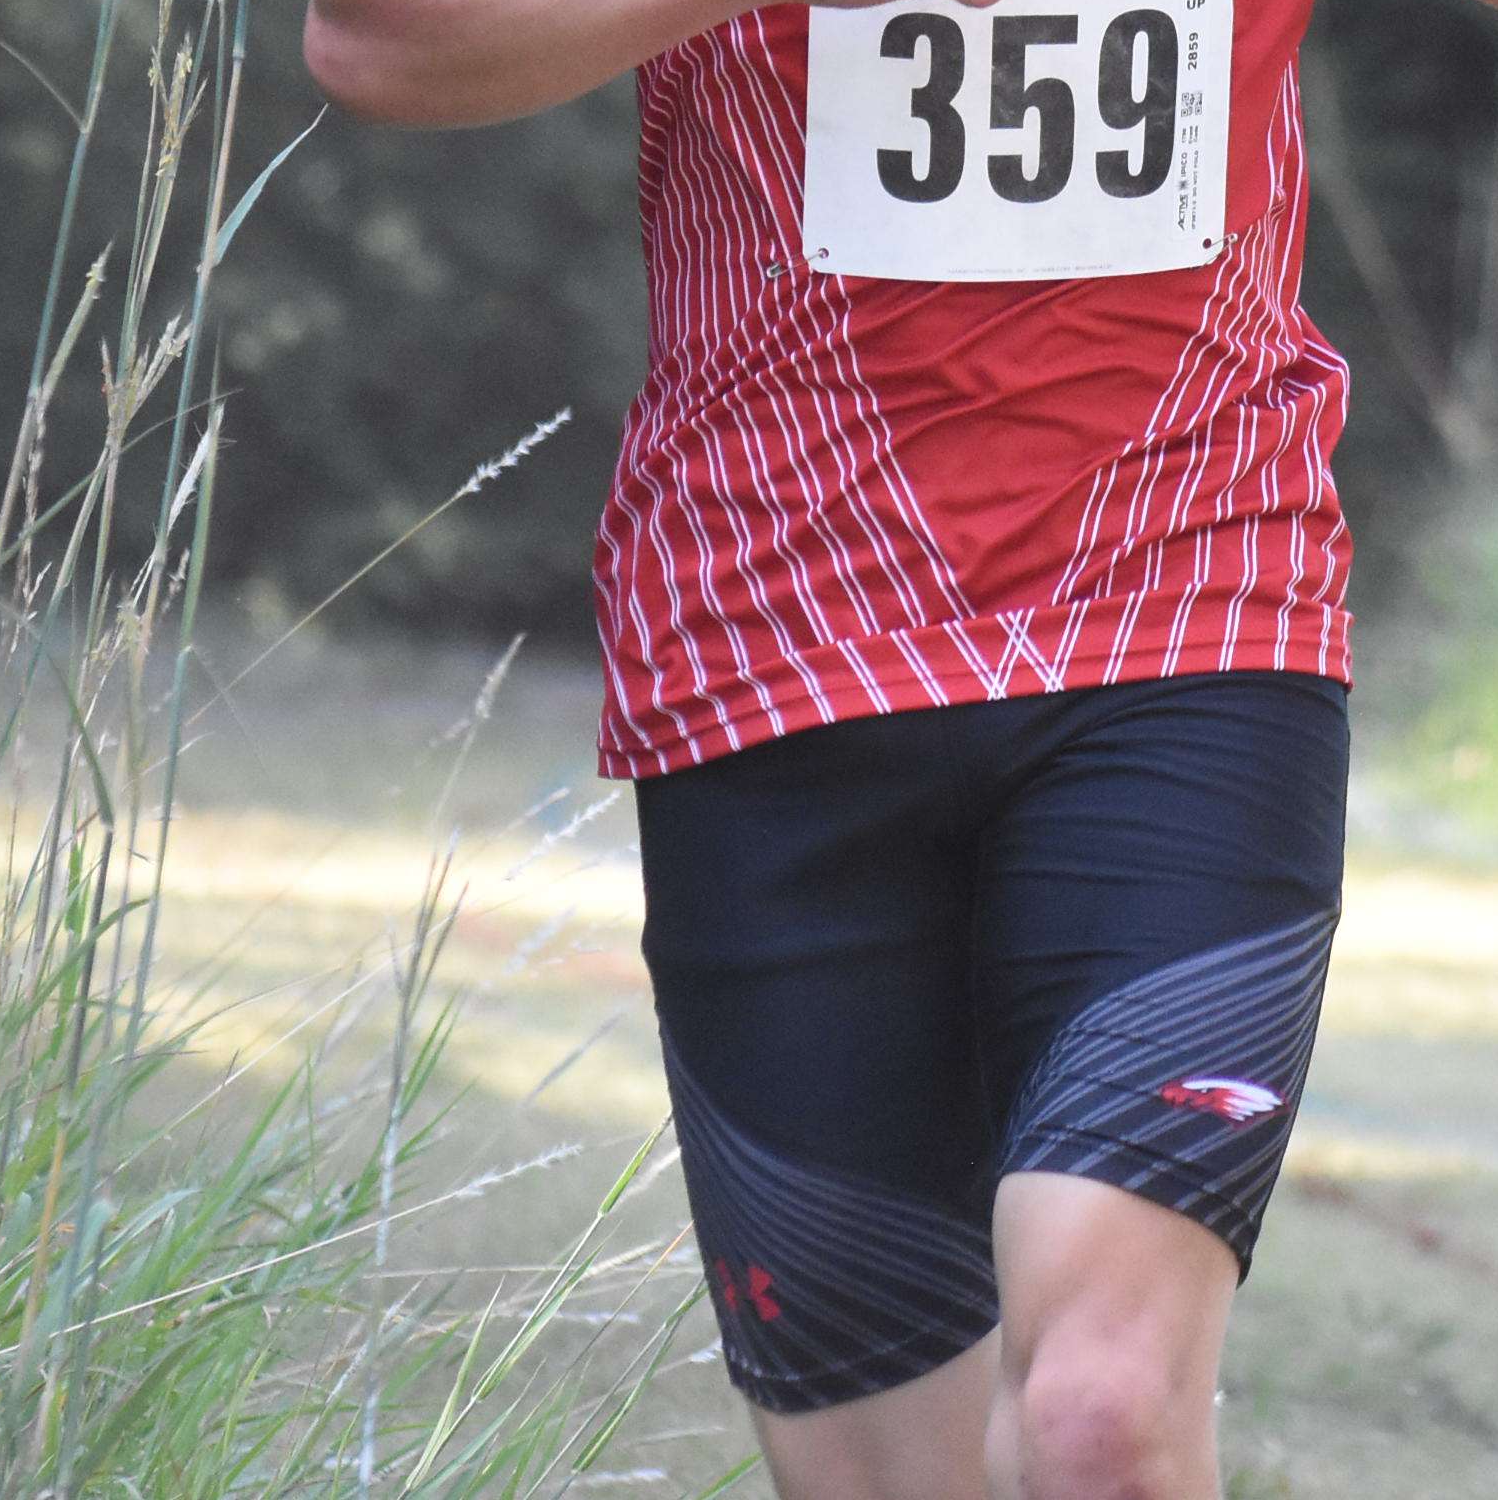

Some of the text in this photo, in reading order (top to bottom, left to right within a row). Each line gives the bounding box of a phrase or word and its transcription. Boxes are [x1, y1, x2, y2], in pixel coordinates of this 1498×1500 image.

[1187, 31, 1199, 71] 2859
[876, 8, 1179, 204] 359
[1177, 193, 1189, 232] ACTIVE
